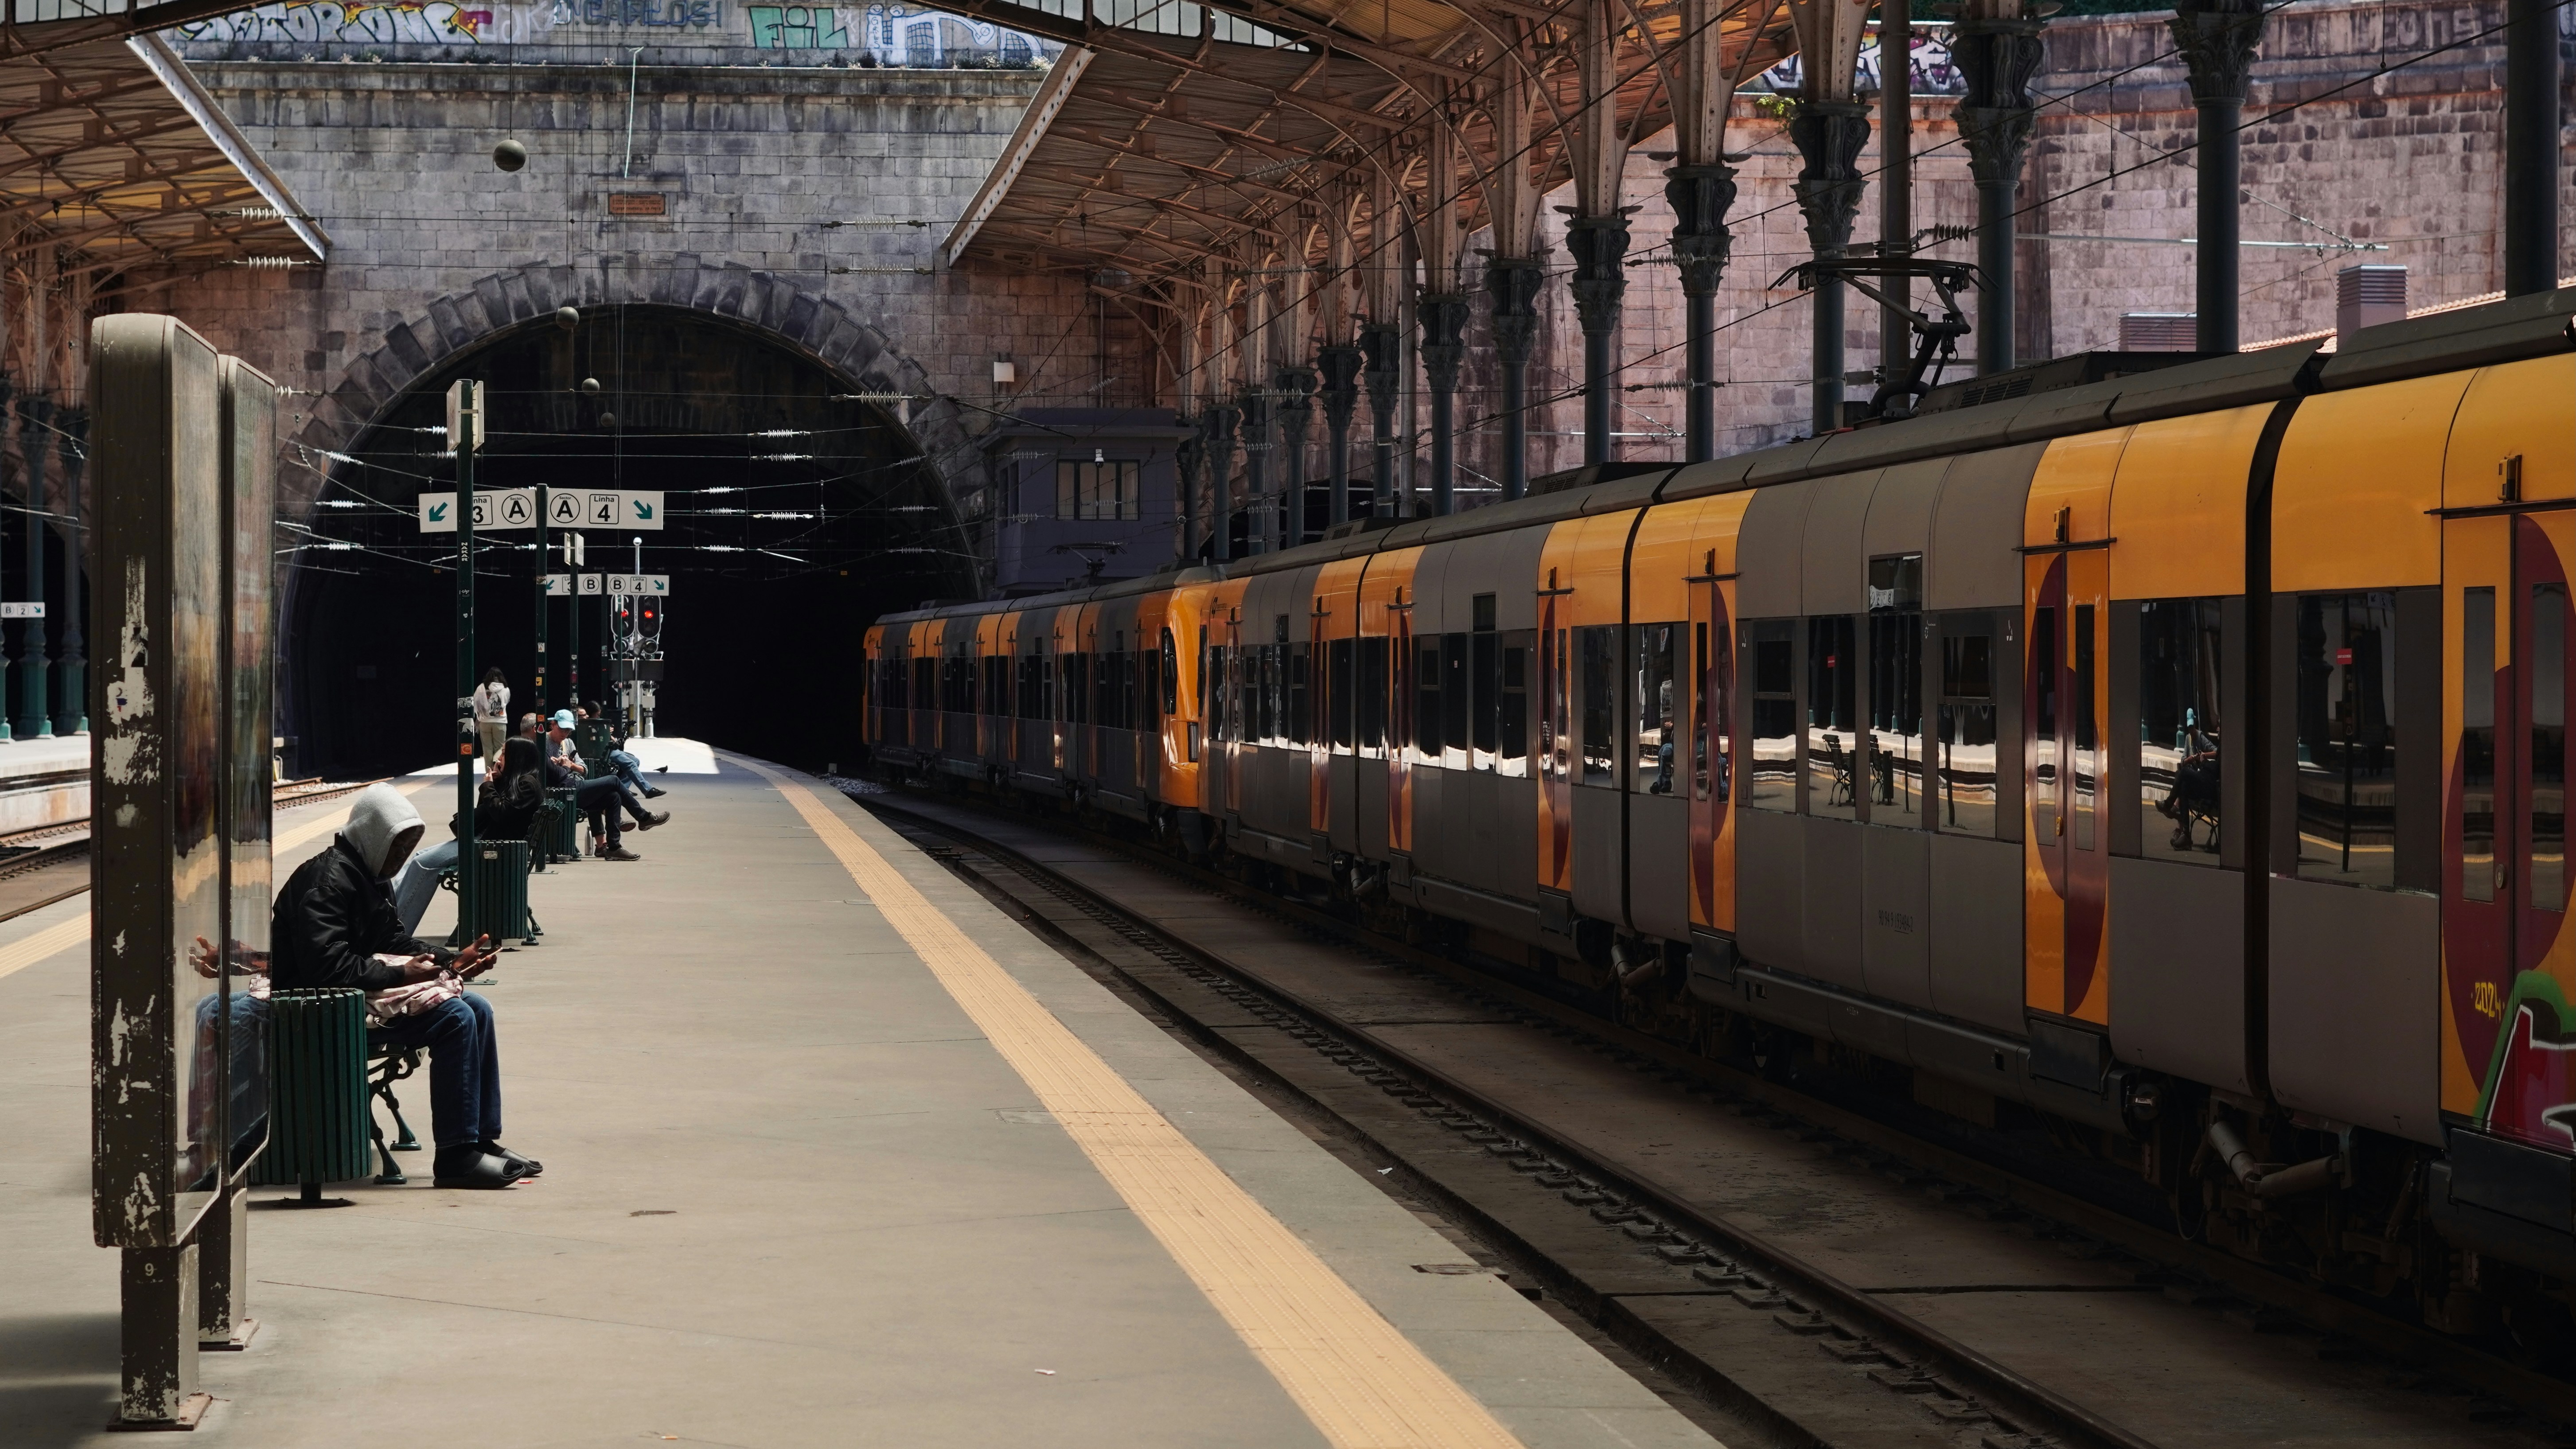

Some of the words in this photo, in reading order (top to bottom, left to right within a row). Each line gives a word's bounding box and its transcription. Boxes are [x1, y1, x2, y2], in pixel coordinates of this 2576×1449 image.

[473, 506, 484, 523] 3
[508, 500, 526, 518] A
[556, 500, 573, 518] A
[597, 504, 610, 522] 4
[587, 580, 595, 589] B
[613, 580, 622, 590] B
[635, 582, 642, 592] 4
[1878, 910, 1884, 925] 90
[2475, 982, 2502, 1022] 2024
[144, 1263, 154, 1277] 9
